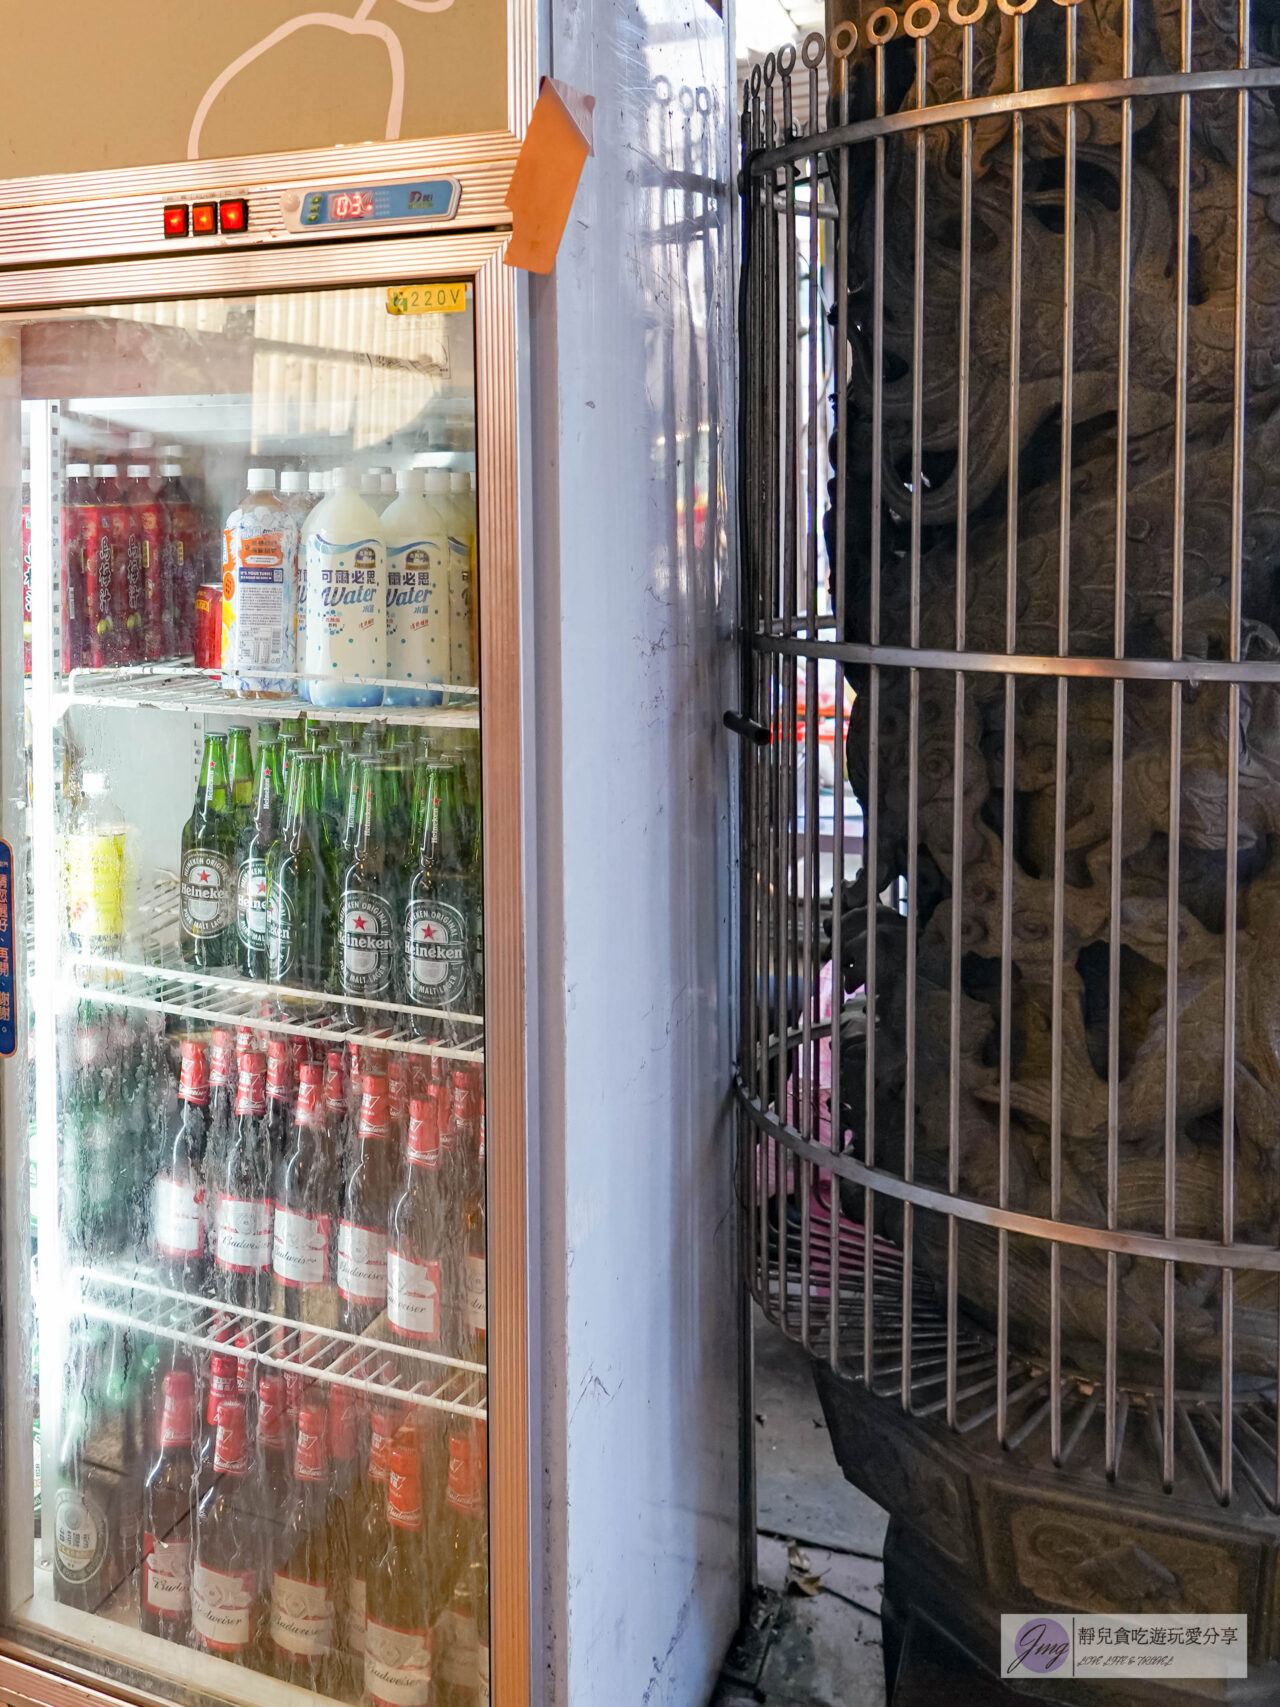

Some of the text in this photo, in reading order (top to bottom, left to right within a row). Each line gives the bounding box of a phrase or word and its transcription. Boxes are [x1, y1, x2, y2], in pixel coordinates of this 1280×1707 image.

[410, 288, 460, 307] 220V
[322, 569, 376, 585] 可爾必思
[388, 571, 430, 586] 爾必思
[321, 585, 377, 606] Water
[238, 894, 267, 910] Heine
[405, 940, 463, 959] Heineken
